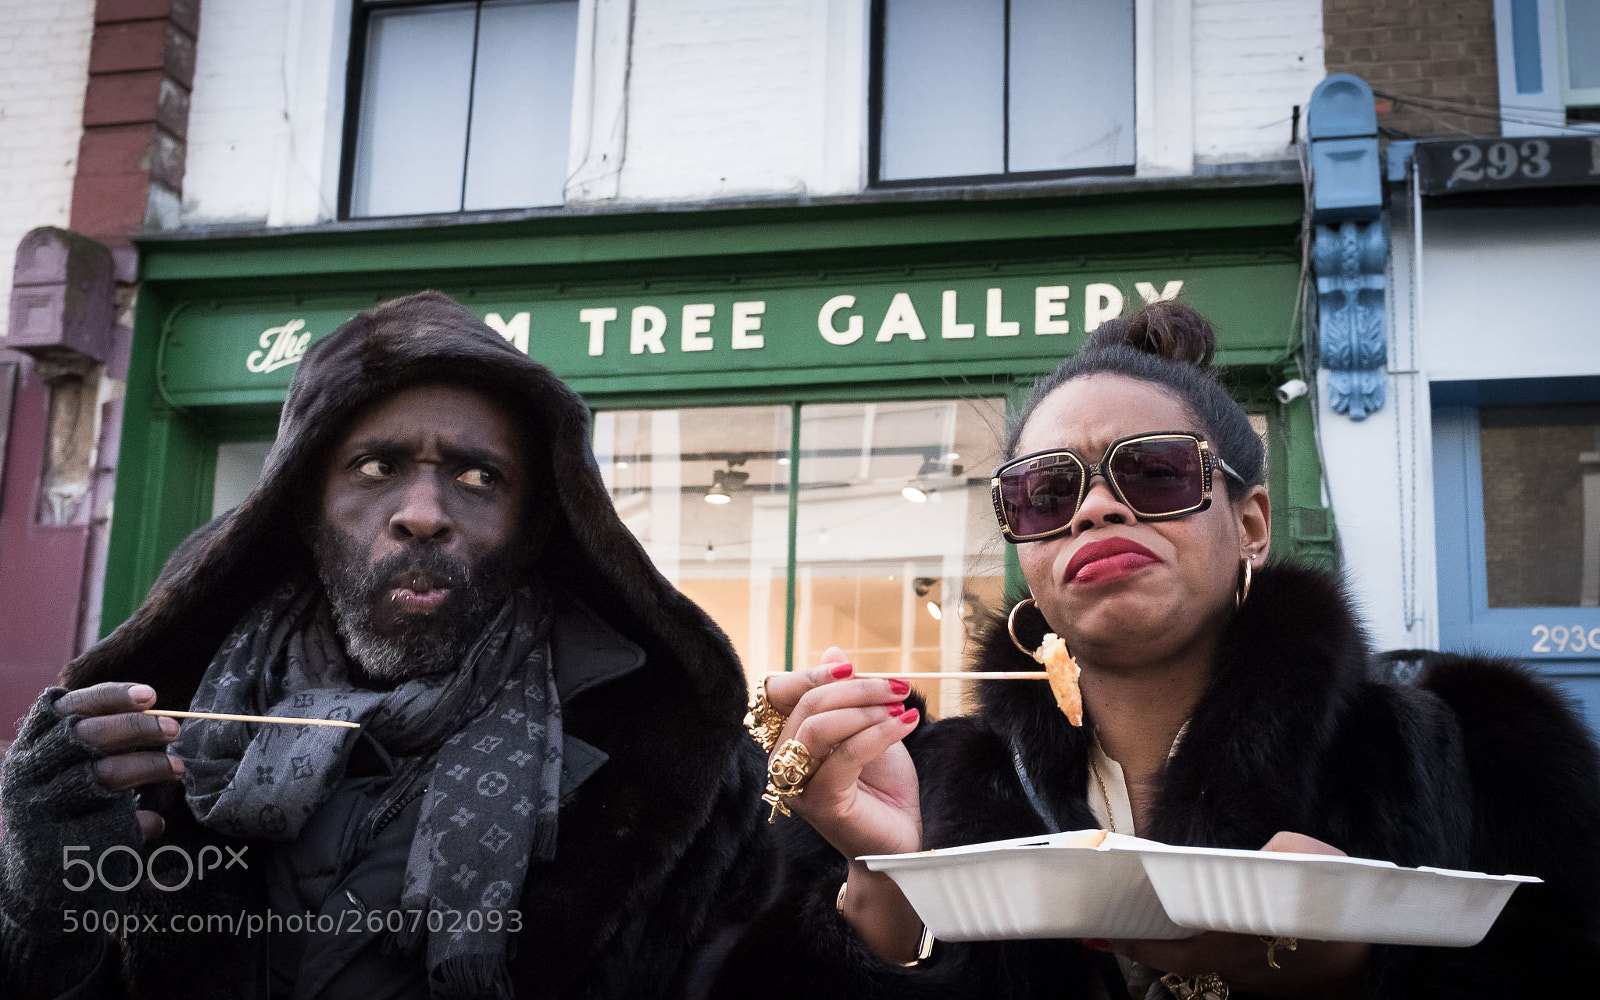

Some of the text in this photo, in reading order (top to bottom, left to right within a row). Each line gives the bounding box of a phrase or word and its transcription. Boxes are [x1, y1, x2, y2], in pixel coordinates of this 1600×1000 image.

[1451, 139, 1551, 184] 293
[246, 318, 312, 374] The
[579, 300, 766, 356] TREE
